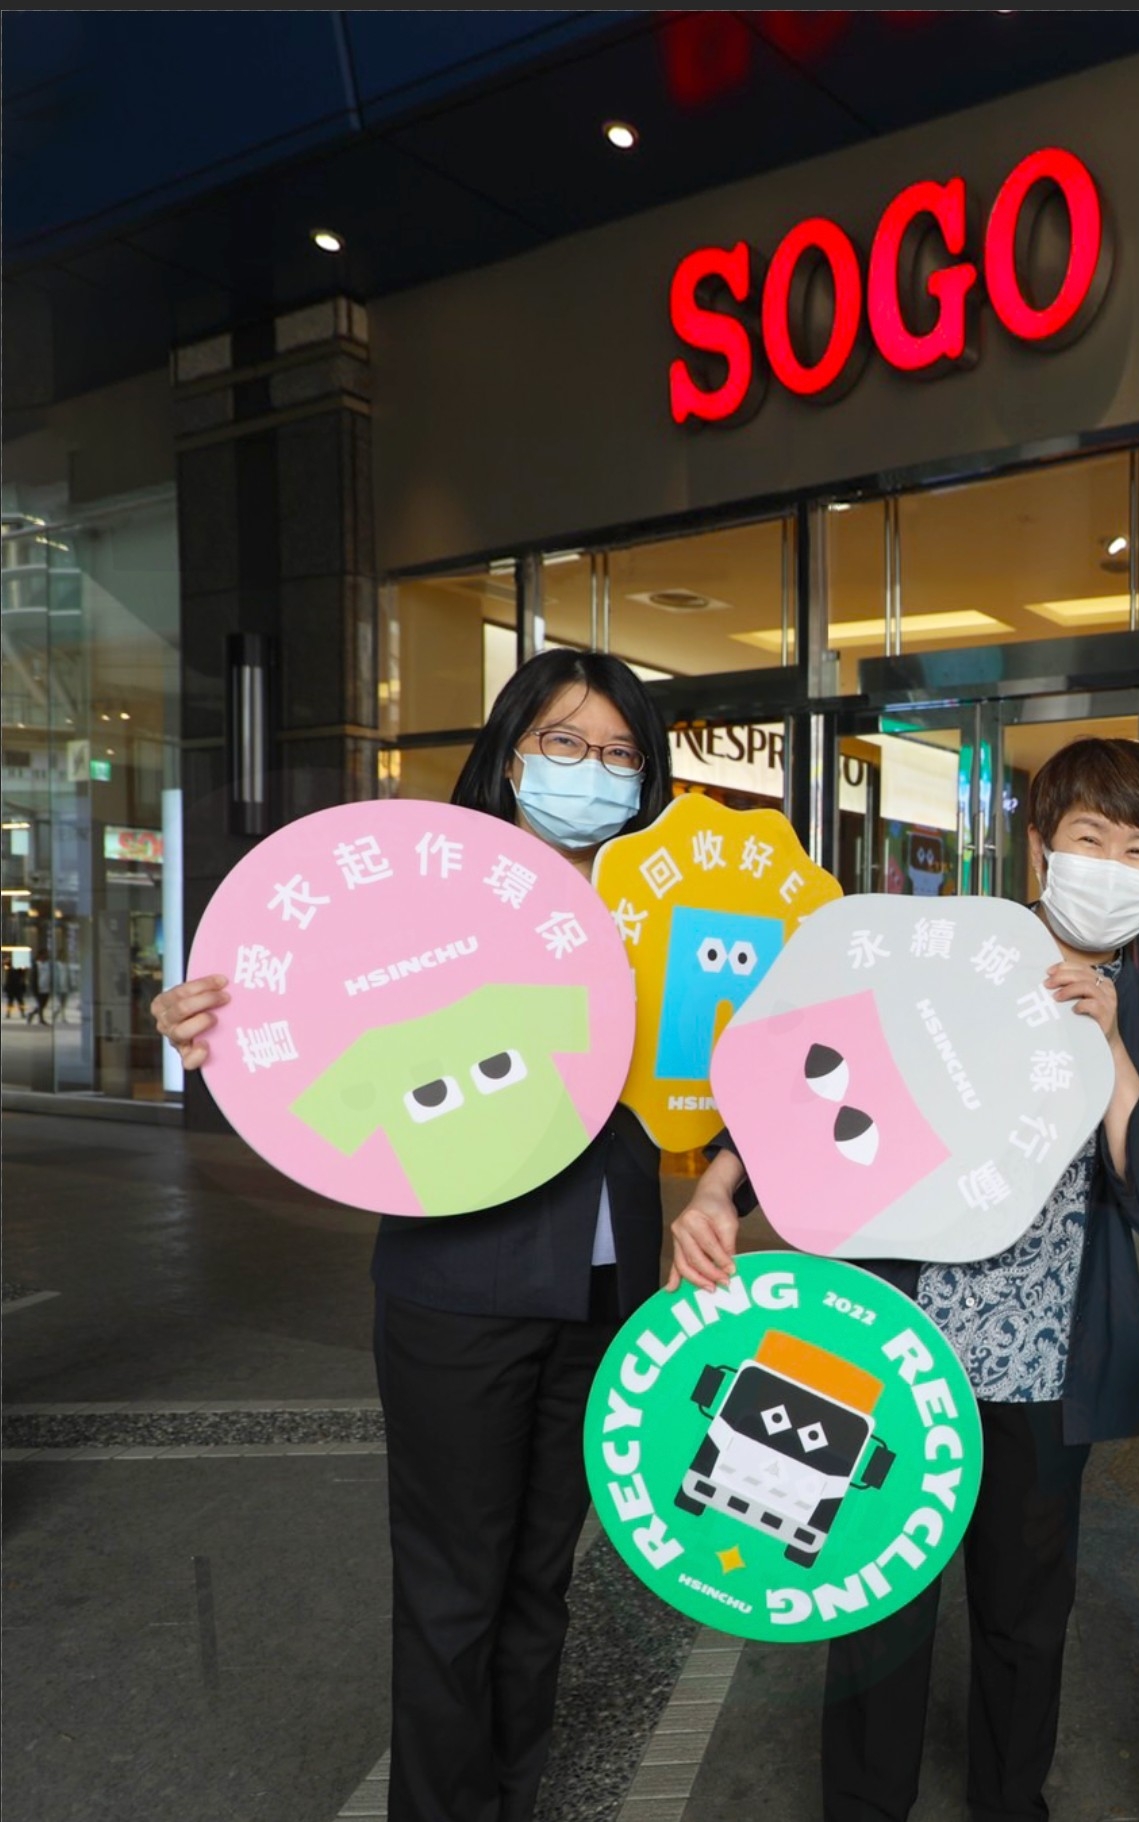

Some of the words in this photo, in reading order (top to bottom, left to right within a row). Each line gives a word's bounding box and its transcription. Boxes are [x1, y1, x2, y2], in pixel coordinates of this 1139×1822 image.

[668, 147, 1102, 424] SOGO
[344, 936, 479, 997] HSINCHU
[916, 998, 982, 1112] HSINCHU
[822, 1291, 877, 1327] 2022
[602, 1272, 799, 1570] RECYCLING
[766, 1328, 964, 1625] RECYCLING
[678, 1573, 753, 1615] HSINCHU
